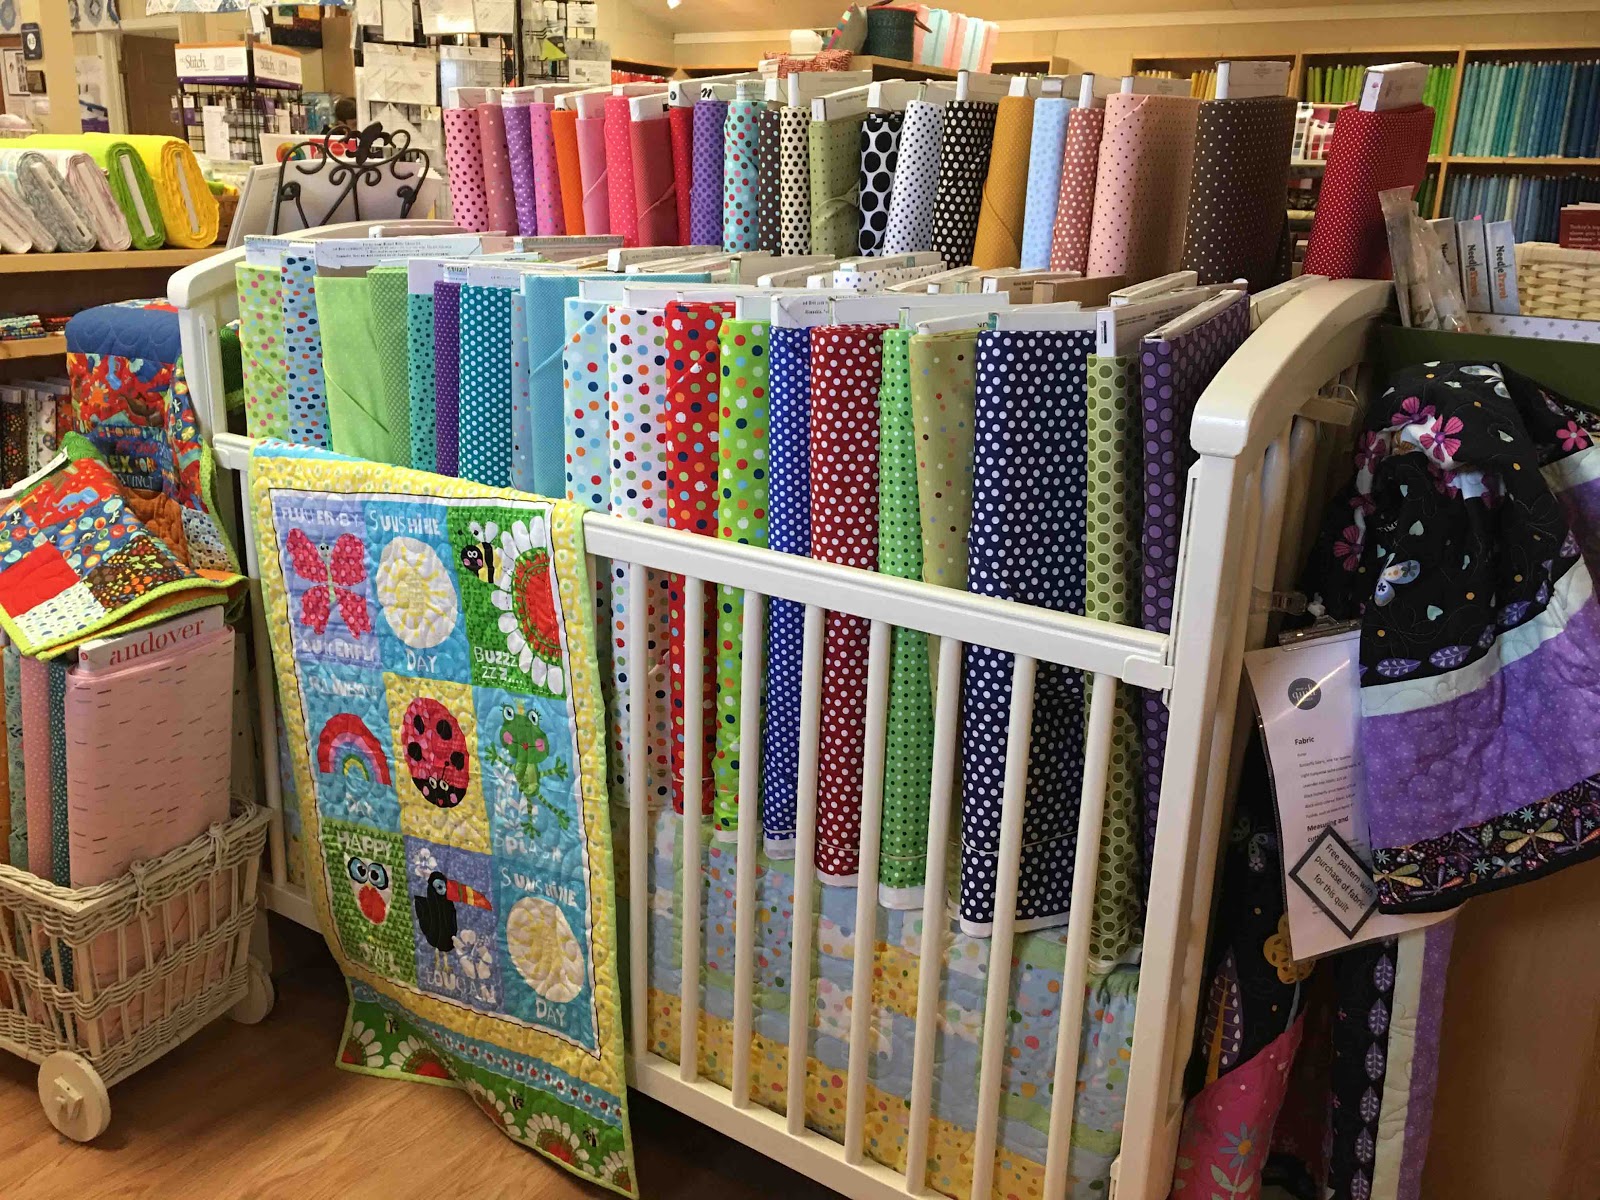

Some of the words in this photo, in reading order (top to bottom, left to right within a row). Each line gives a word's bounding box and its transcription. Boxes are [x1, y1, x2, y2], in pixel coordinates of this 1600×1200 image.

[109, 619, 205, 666] andover
[406, 649, 437, 674] DAY
[1294, 736, 1315, 745] Fabric
[1338, 815, 1349, 824] and
[336, 830, 392, 860] HAPPY
[1314, 855, 1341, 885] purchase
[1341, 882, 1350, 892] of
[1347, 888, 1365, 909] fabric
[1325, 843, 1340, 861] Free
[1338, 858, 1361, 884] pattern
[1360, 881, 1374, 897] with
[1313, 873, 1325, 885] for
[1322, 884, 1335, 900] this
[1334, 896, 1350, 913] quilt
[535, 997, 566, 1027] DAY
